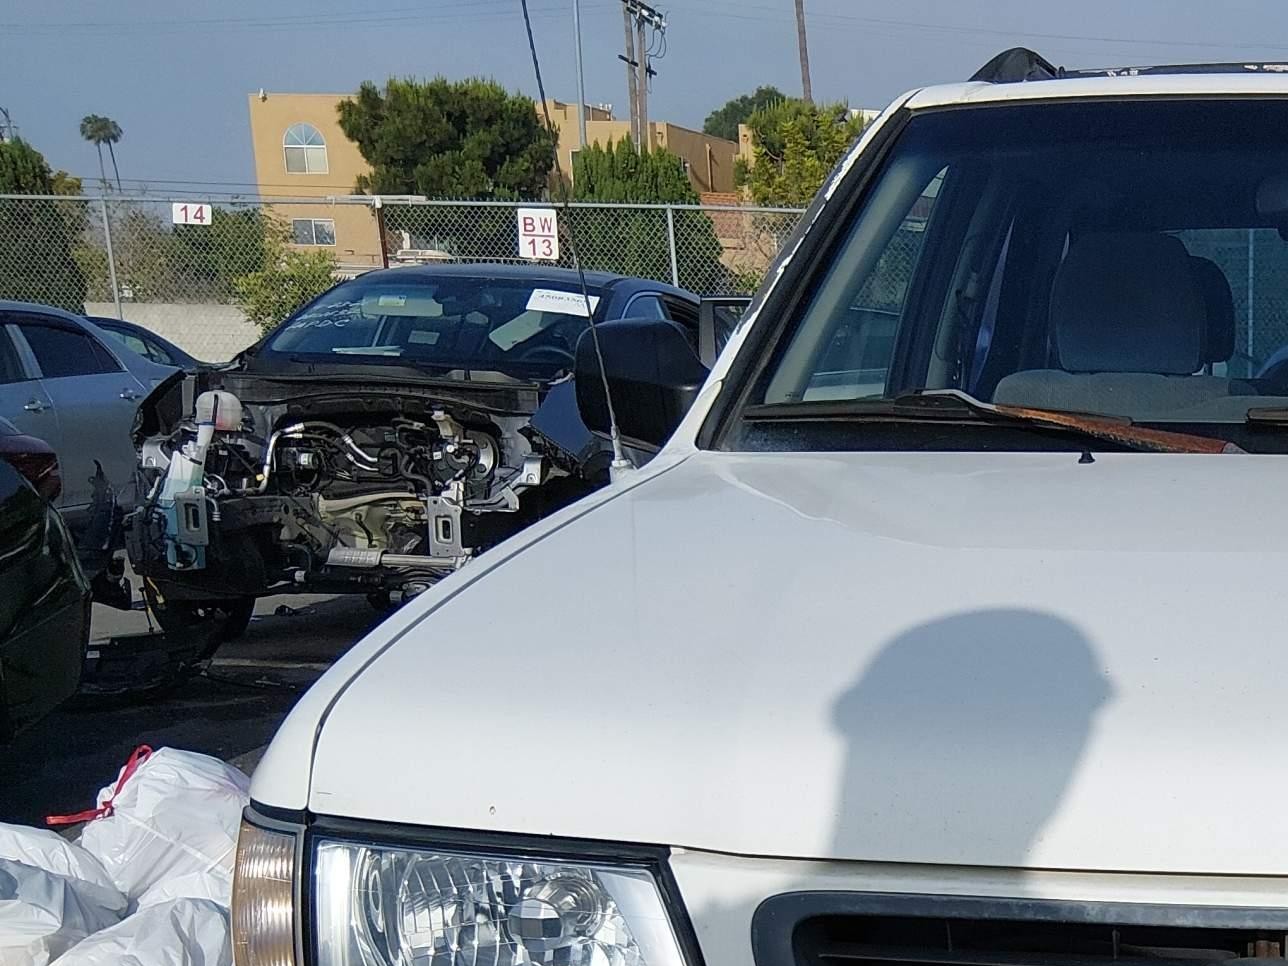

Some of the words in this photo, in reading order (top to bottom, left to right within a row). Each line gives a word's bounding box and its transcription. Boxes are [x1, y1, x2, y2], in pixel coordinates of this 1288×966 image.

[180, 205, 206, 223] 14
[523, 216, 553, 233] BW
[528, 238, 553, 257] 13
